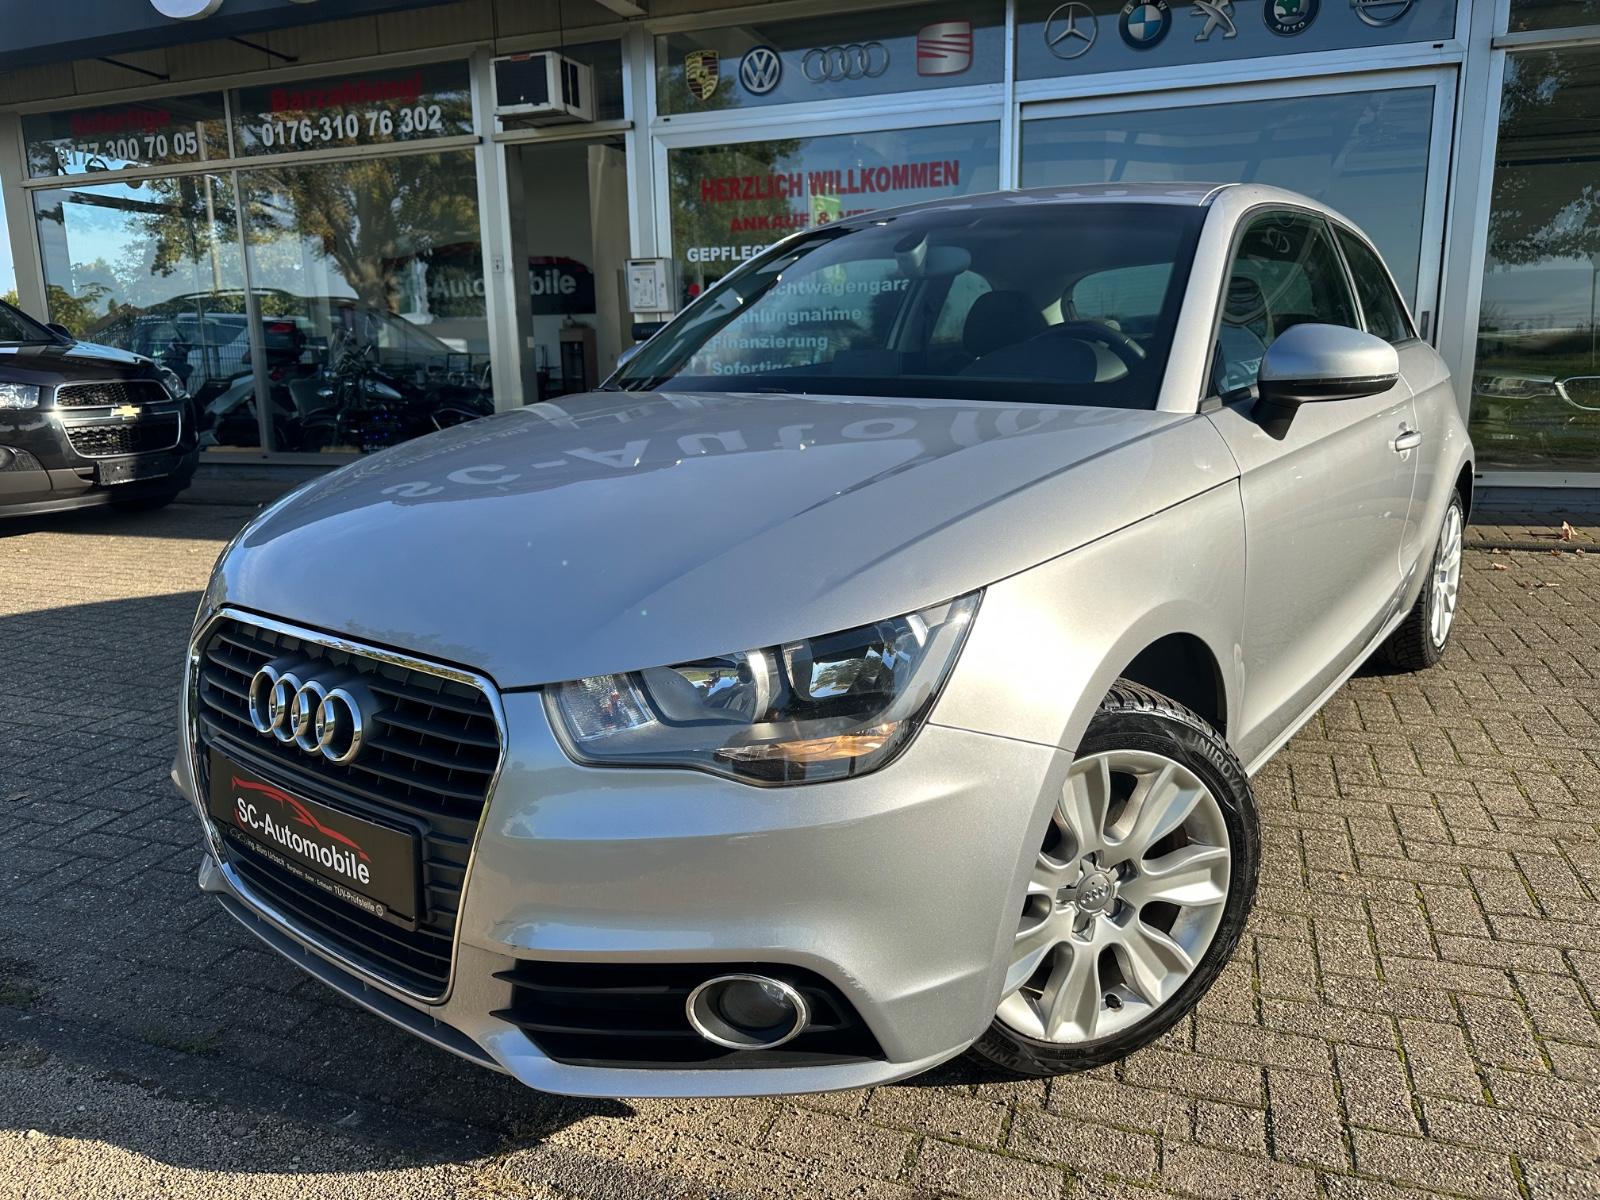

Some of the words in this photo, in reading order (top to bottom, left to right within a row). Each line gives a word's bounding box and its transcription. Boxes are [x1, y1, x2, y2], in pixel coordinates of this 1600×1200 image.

[1276, 21, 1306, 32] AUTO
[261, 114, 359, 147] 0176-310
[365, 110, 393, 135] 76
[401, 105, 442, 133] 302
[144, 135, 168, 158] 70
[173, 132, 198, 154] 05
[701, 172, 803, 203] HERZLICH
[808, 160, 960, 197] WILLKOMMEN
[730, 212, 810, 233] ANKAUF
[687, 244, 772, 262] GEPFLEG
[237, 798, 370, 884] SC-Automobile
